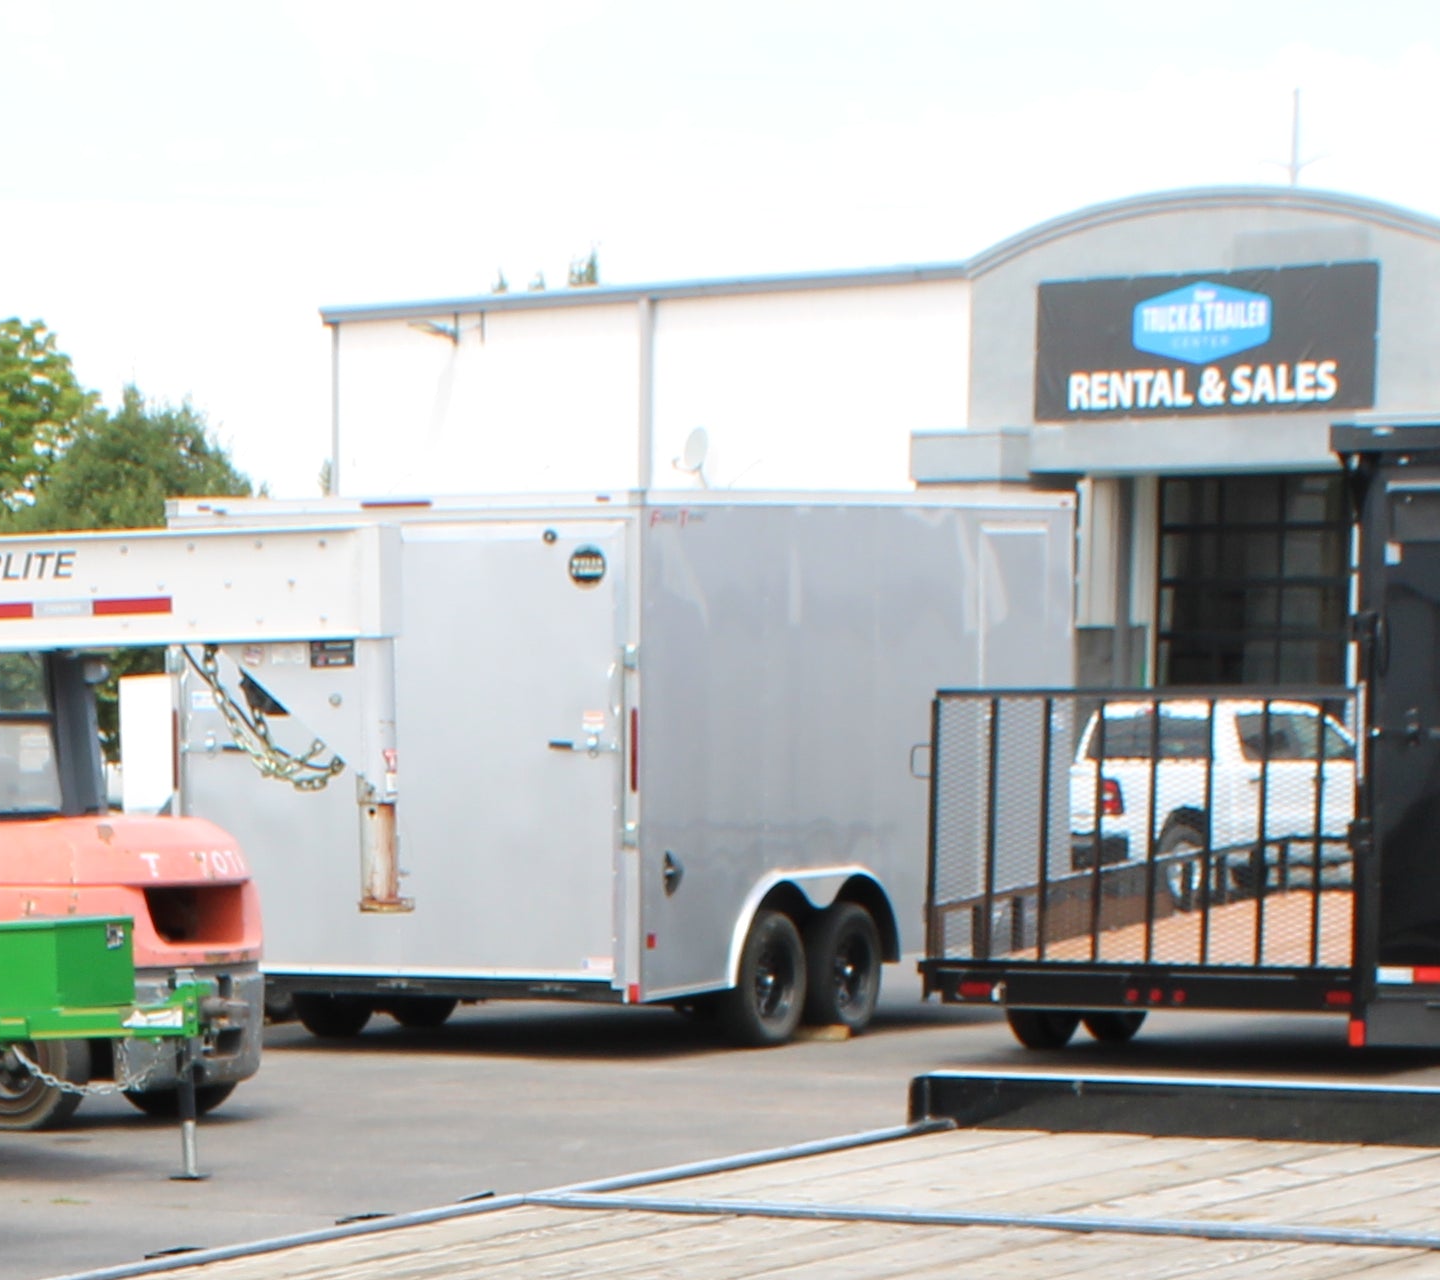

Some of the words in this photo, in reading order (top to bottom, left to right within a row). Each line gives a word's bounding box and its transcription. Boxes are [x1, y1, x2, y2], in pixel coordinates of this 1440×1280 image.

[1068, 368, 1193, 411] RENTAL
[1198, 364, 1226, 406] &
[1231, 359, 1338, 405] SALES
